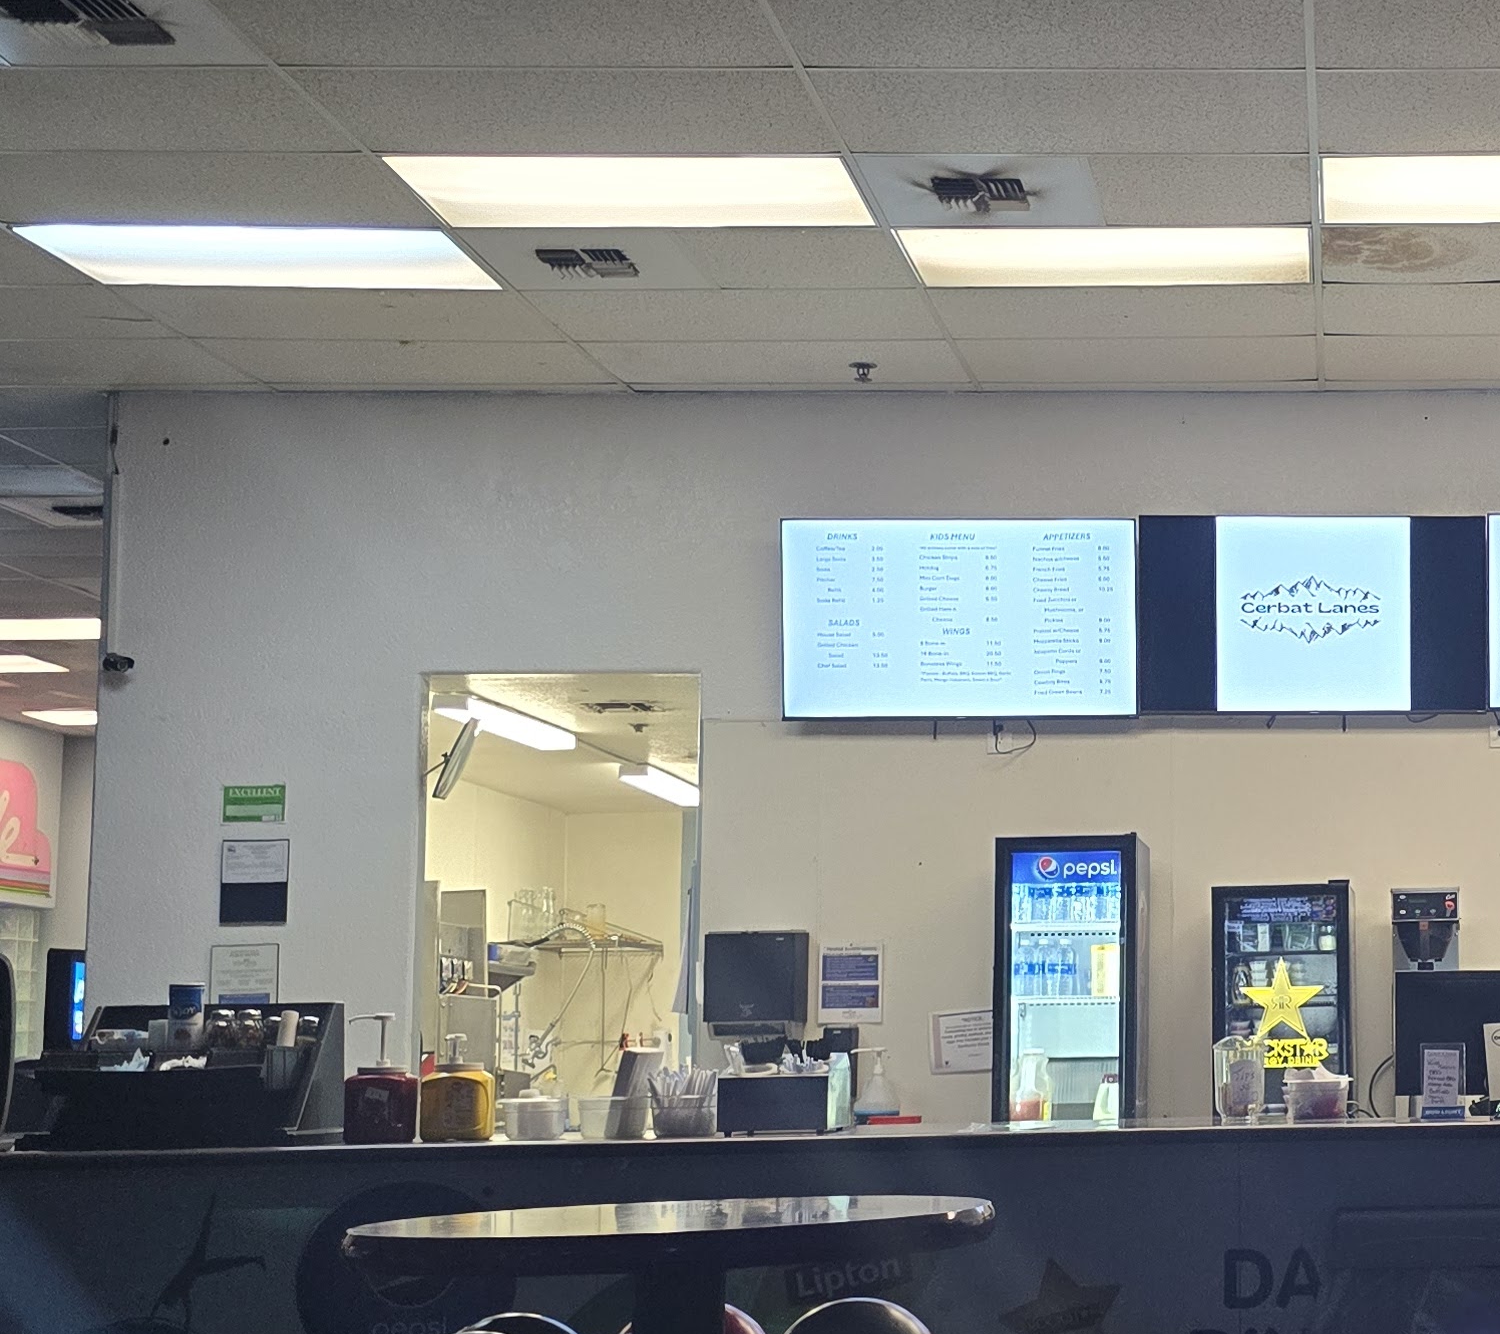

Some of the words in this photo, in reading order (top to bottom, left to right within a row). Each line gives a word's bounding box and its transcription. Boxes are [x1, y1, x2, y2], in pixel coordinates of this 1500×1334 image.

[1241, 602, 1315, 614] Cerbat
[1318, 602, 1380, 614] Lanes
[229, 787, 282, 798] EXCELLENT
[1063, 860, 1118, 878] pepsi
[796, 1258, 901, 1298] Lipton
